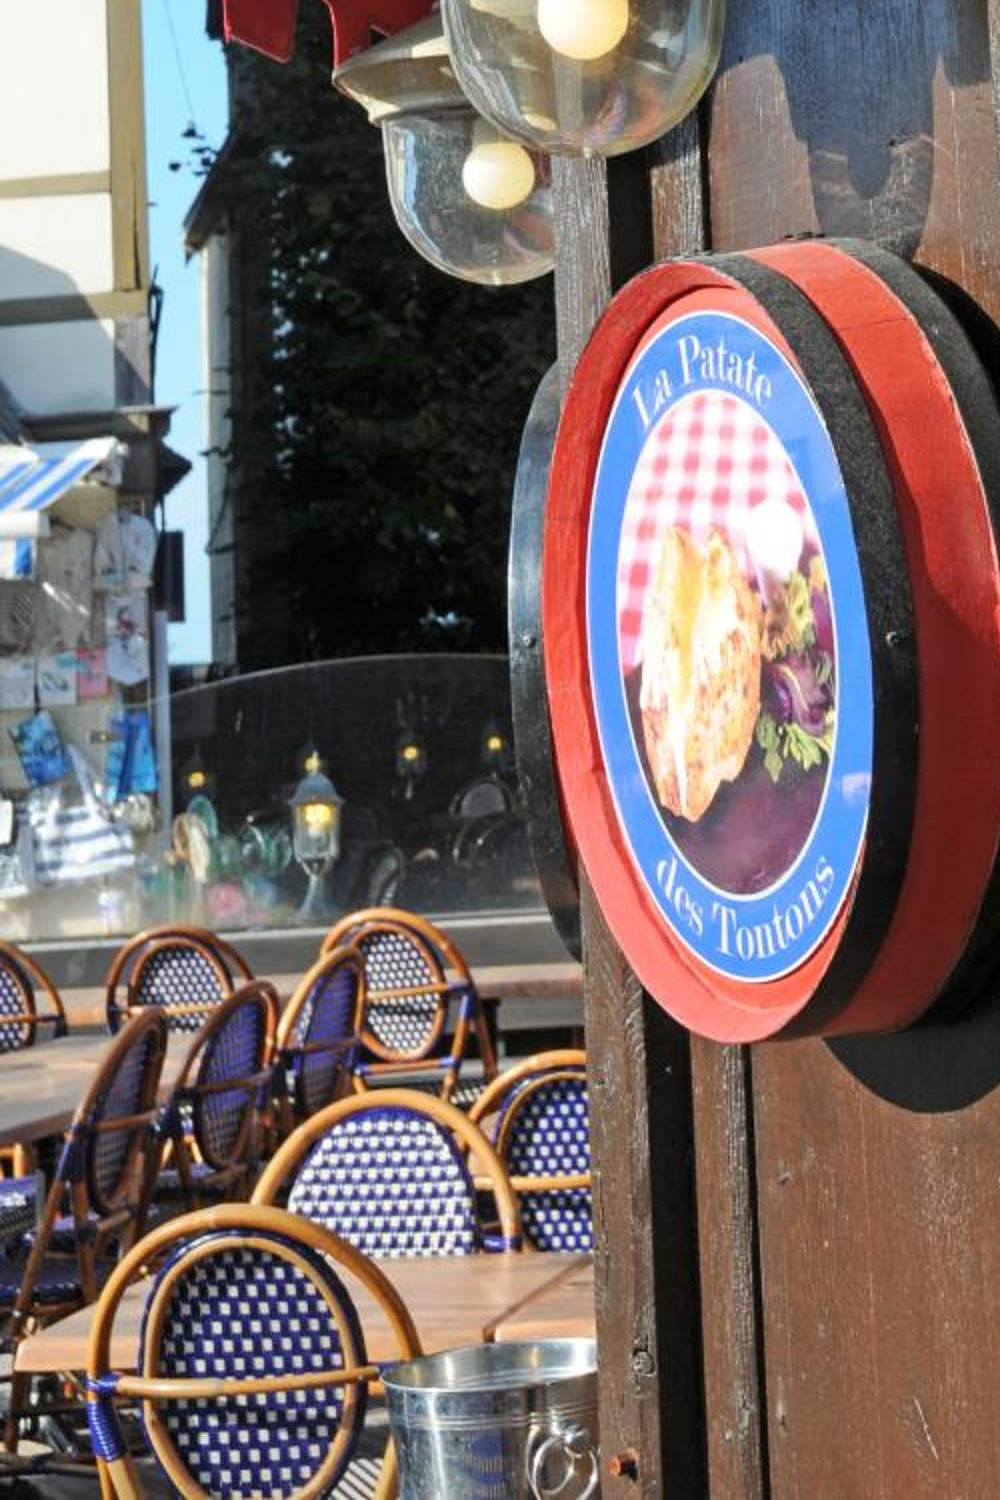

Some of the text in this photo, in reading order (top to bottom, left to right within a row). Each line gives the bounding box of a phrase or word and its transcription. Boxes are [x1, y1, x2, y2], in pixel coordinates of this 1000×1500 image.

[631, 334, 772, 430] La Patate
[656, 854, 834, 961] des Tontons
